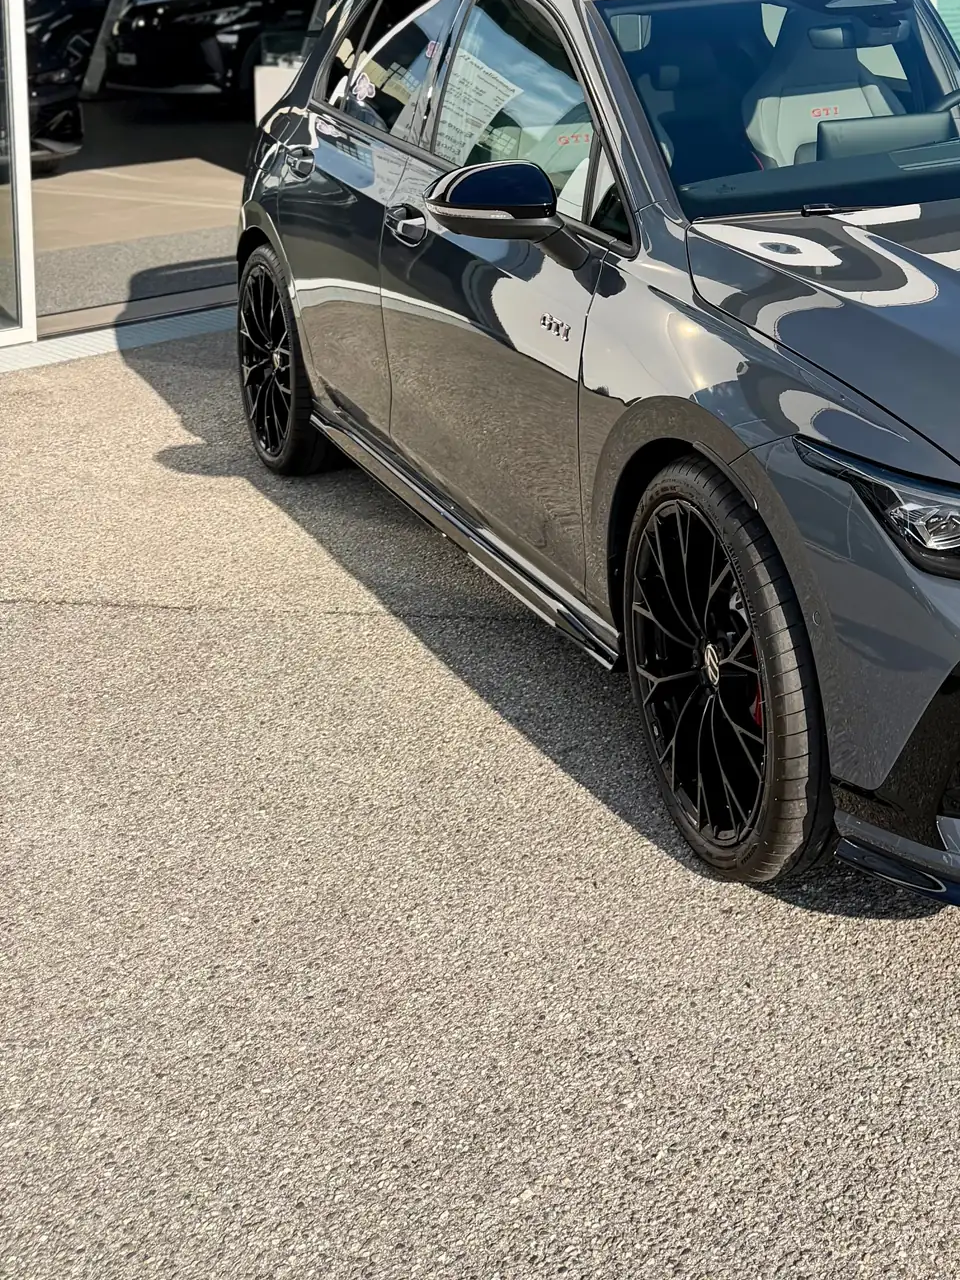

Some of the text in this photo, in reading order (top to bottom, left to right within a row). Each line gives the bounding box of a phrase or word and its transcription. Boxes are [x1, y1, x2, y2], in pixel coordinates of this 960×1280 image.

[811, 106, 839, 118] GTI
[557, 133, 590, 146] GTI
[540, 312, 571, 342] GTI
